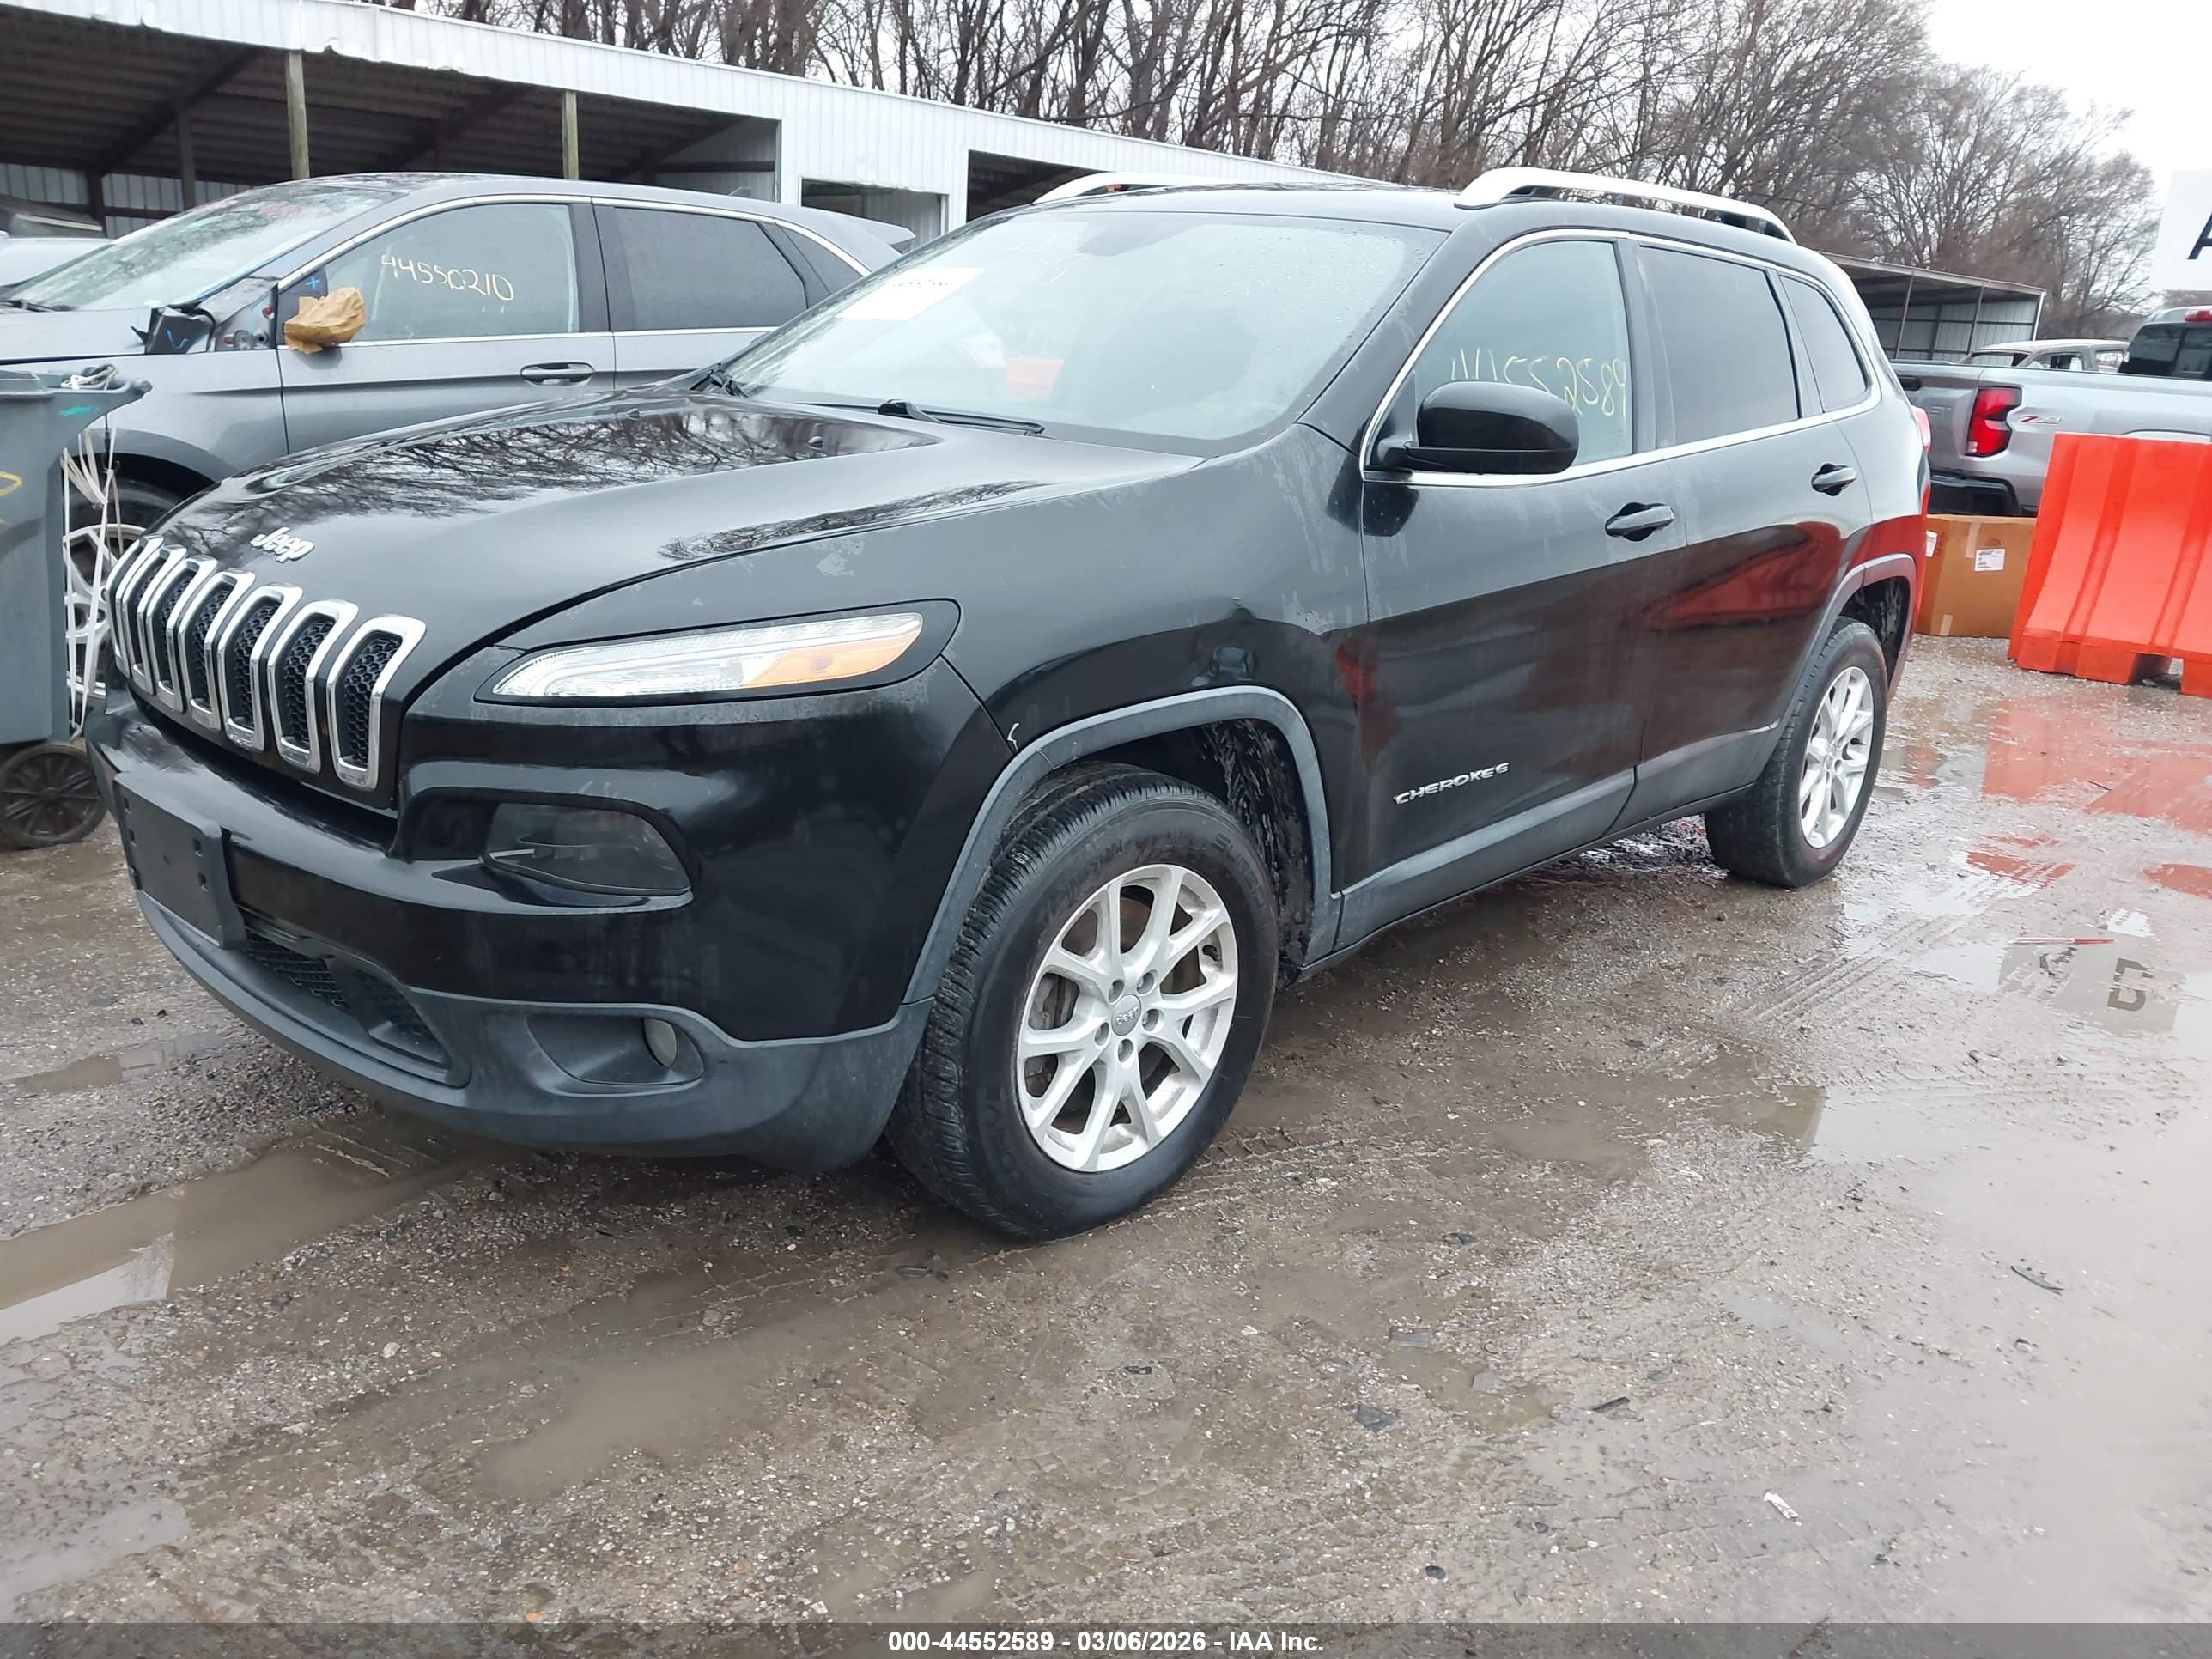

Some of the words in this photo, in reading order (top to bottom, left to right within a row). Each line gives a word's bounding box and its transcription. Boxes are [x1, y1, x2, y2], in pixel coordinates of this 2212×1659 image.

[380, 254, 514, 301] 44550210
[250, 526, 314, 562] Jeep
[1394, 762, 1510, 805] CHEROKEE
